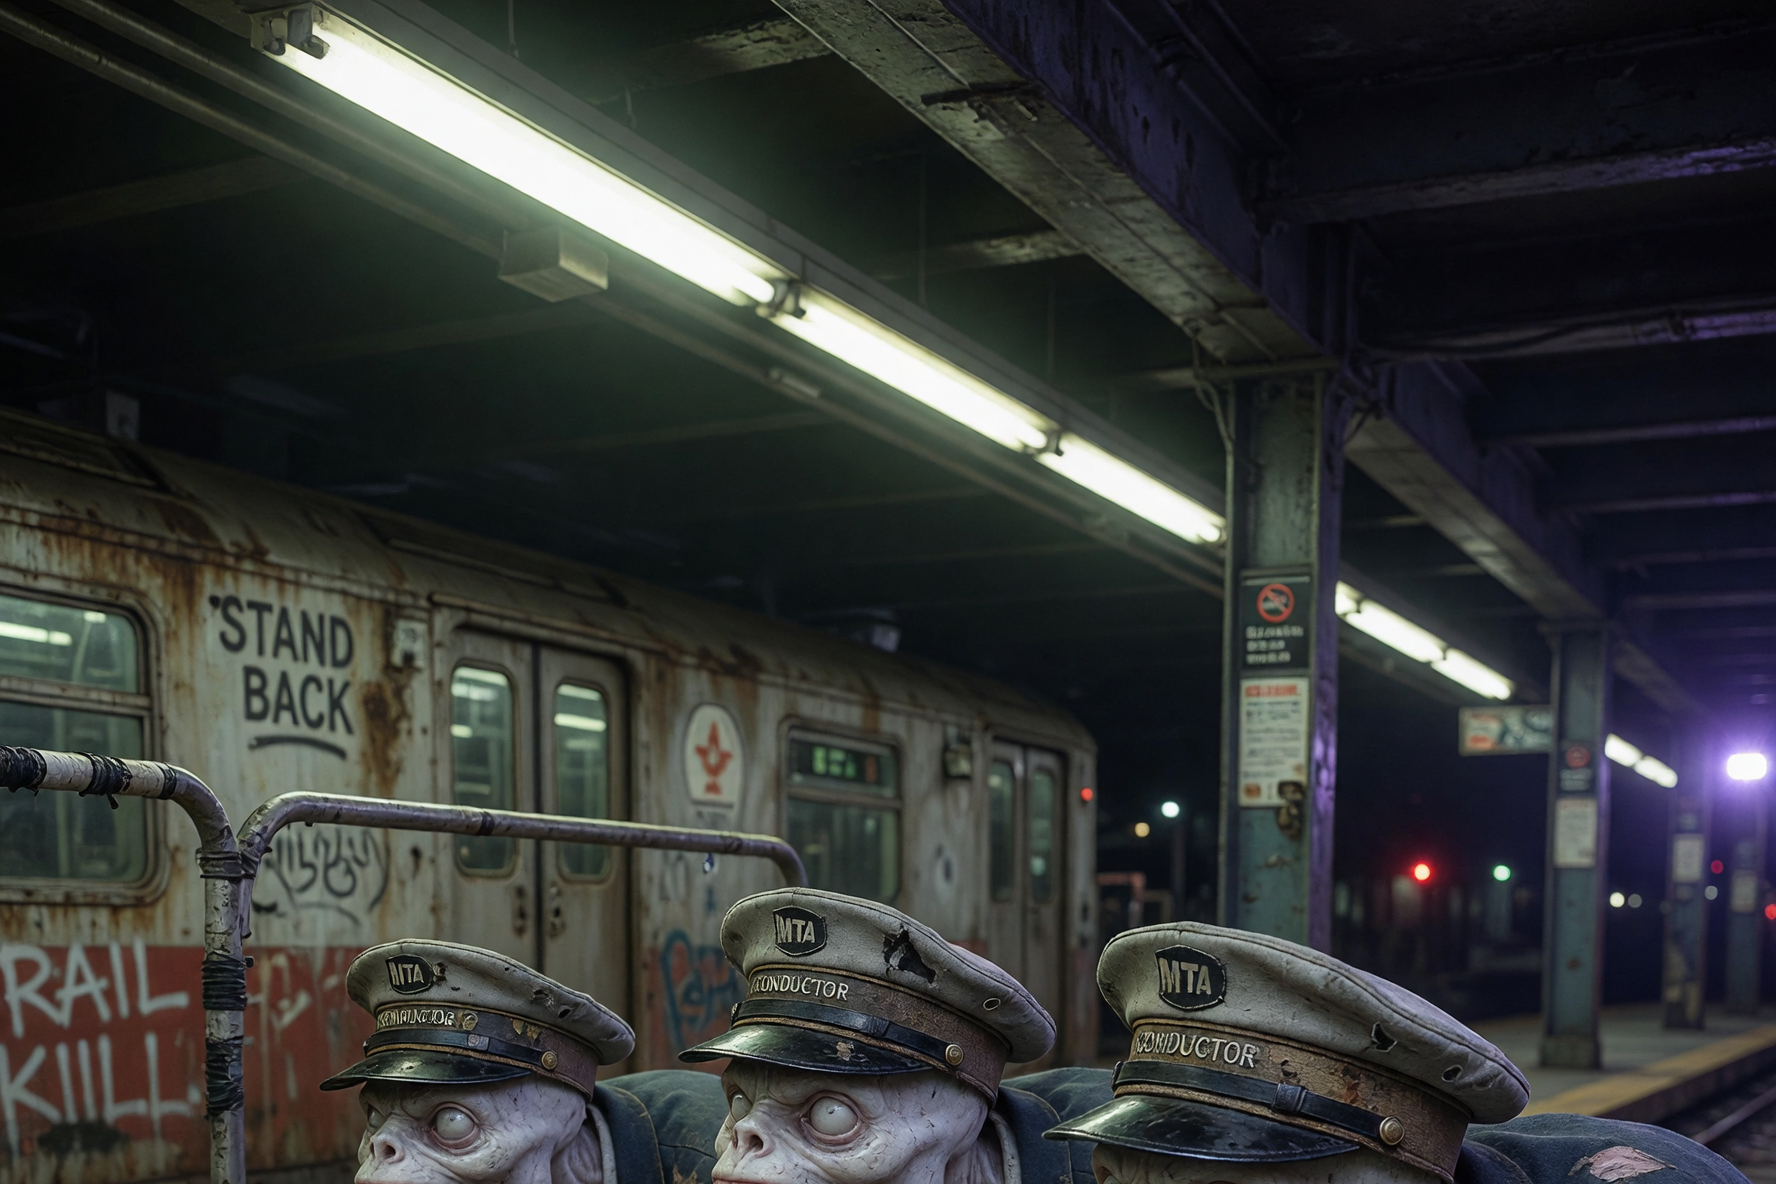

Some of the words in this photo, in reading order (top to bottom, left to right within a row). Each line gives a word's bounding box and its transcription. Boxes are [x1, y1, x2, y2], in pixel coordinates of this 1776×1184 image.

[219, 595, 354, 669] STAND
[243, 665, 354, 736] BACK
[774, 913, 816, 944] MTA
[0, 936, 190, 1039] RAIL
[1158, 957, 1213, 996] MTA
